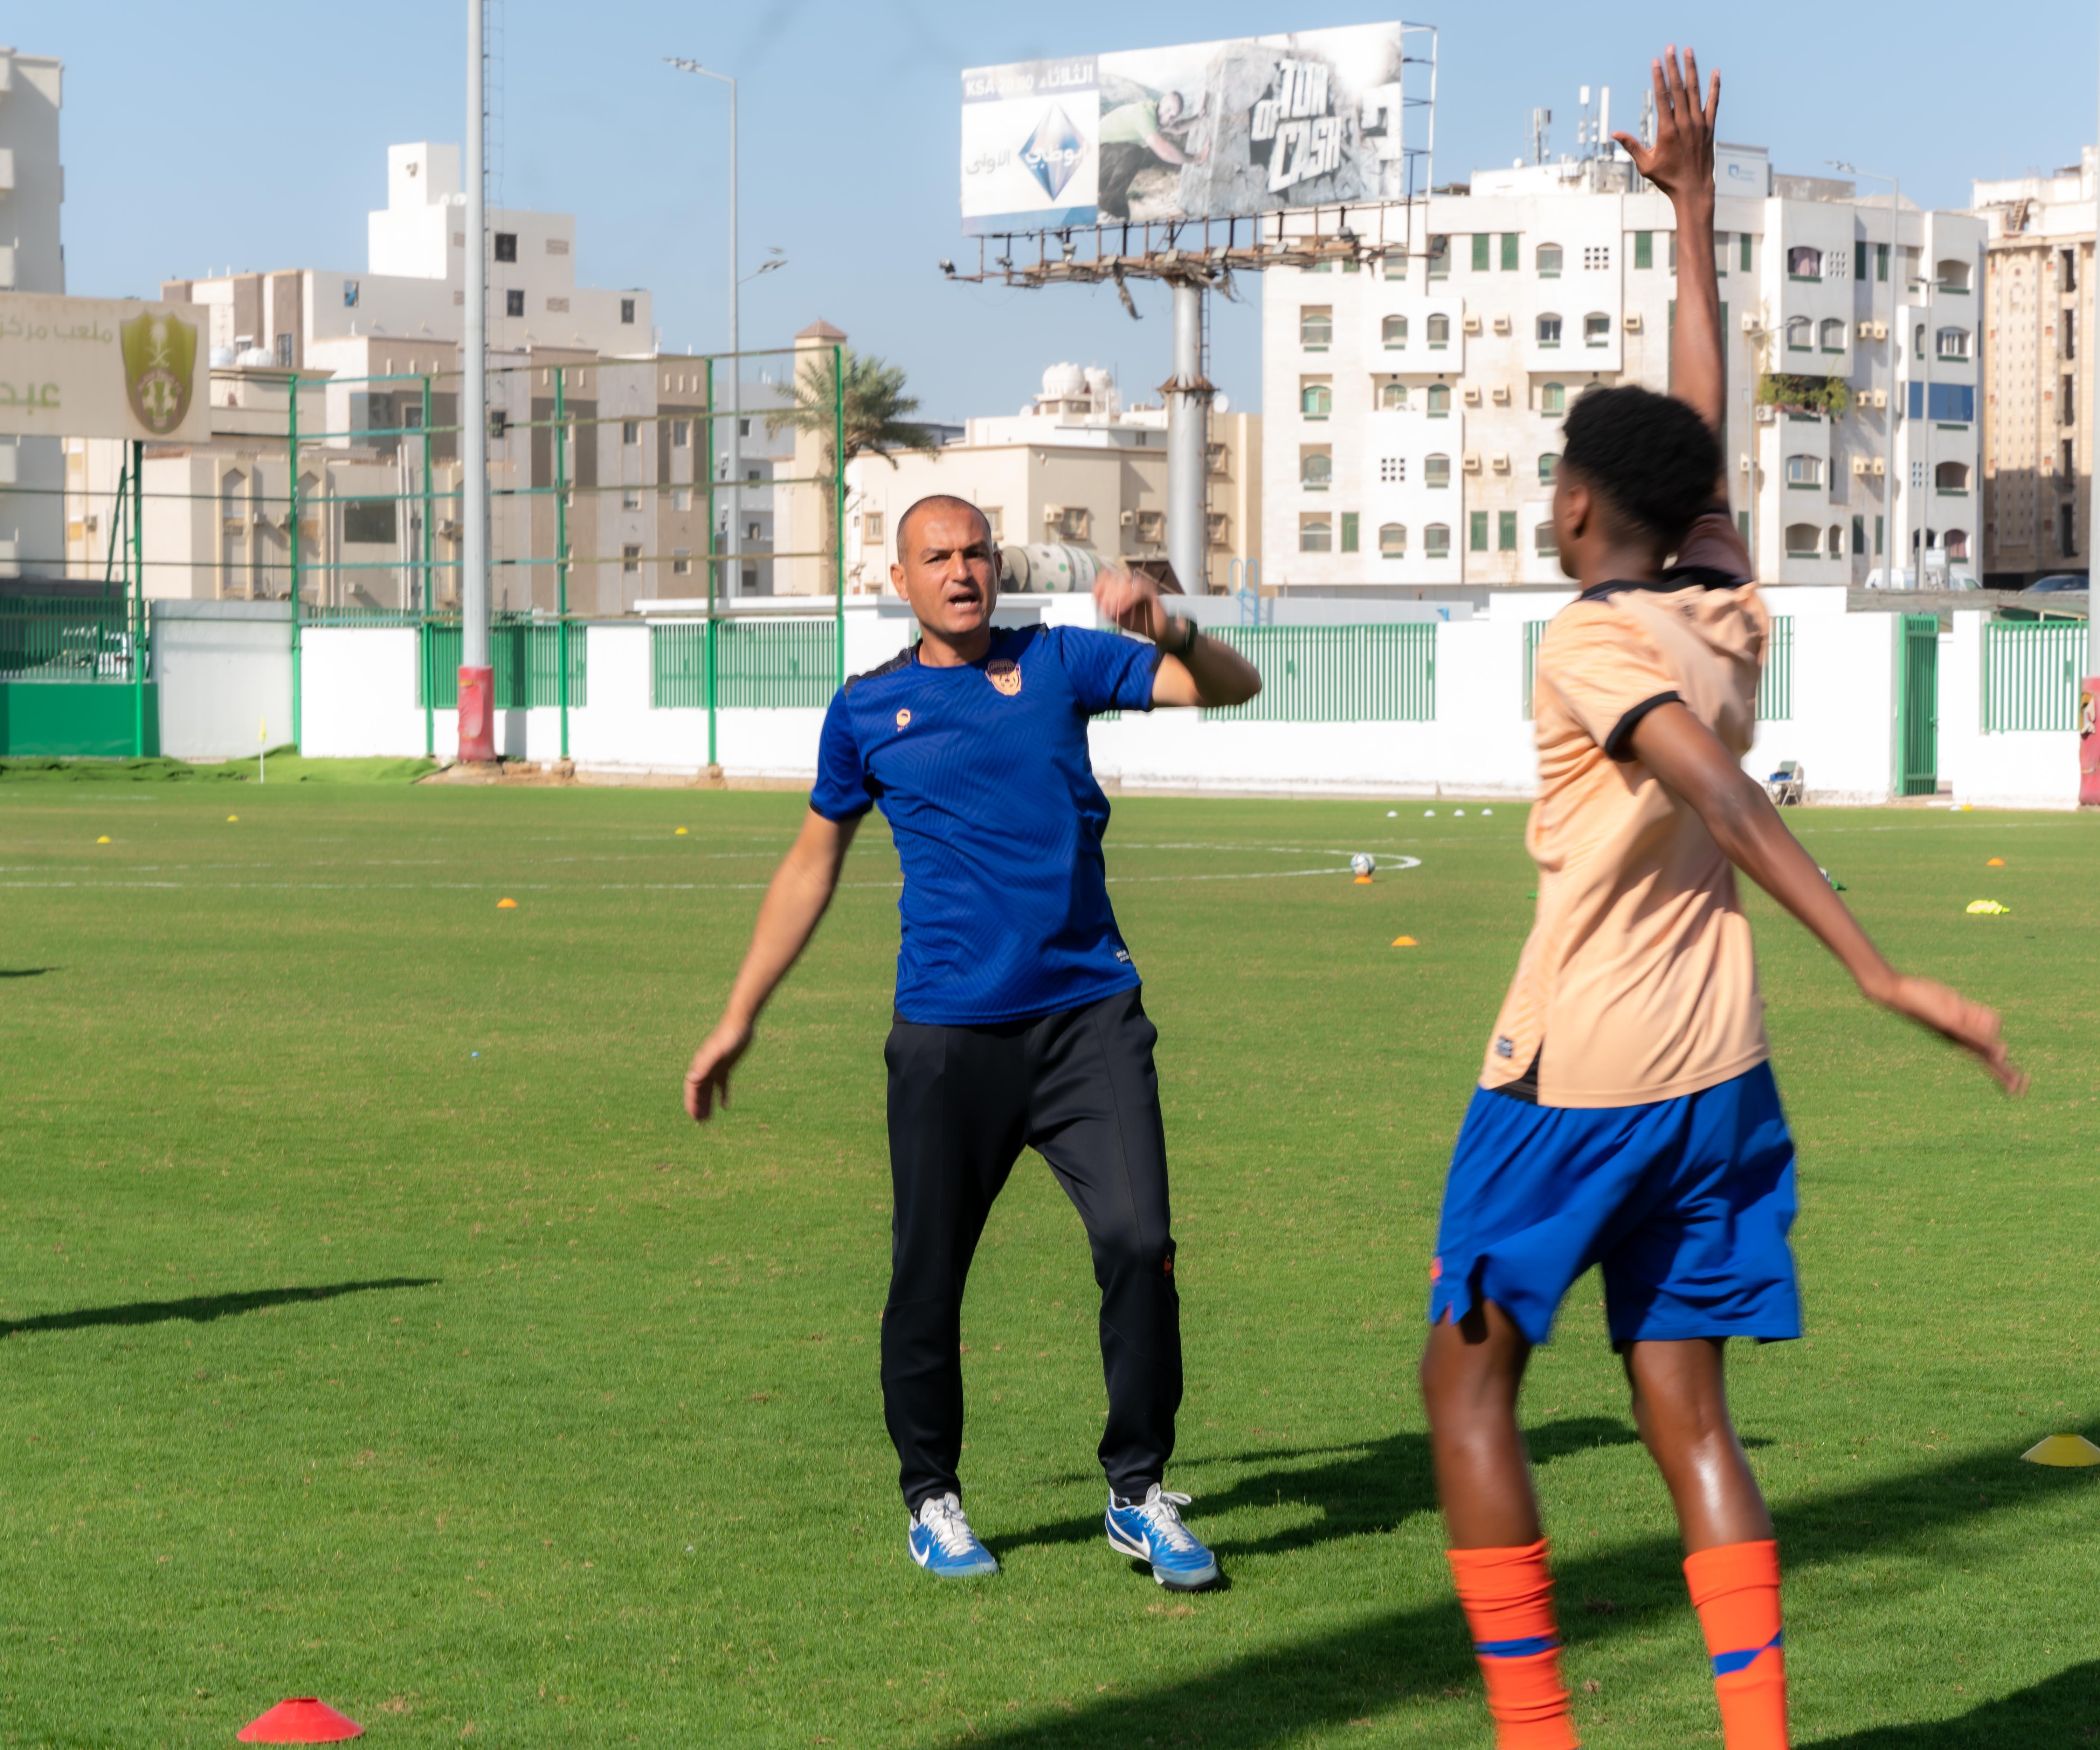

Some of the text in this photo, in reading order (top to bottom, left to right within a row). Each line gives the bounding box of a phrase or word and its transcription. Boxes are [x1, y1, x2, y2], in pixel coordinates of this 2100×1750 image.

[966, 78, 995, 97] KSA
[1279, 59, 1328, 119] TON
[1267, 116, 1342, 193] CASH
[54, 318, 113, 344] ملعب
